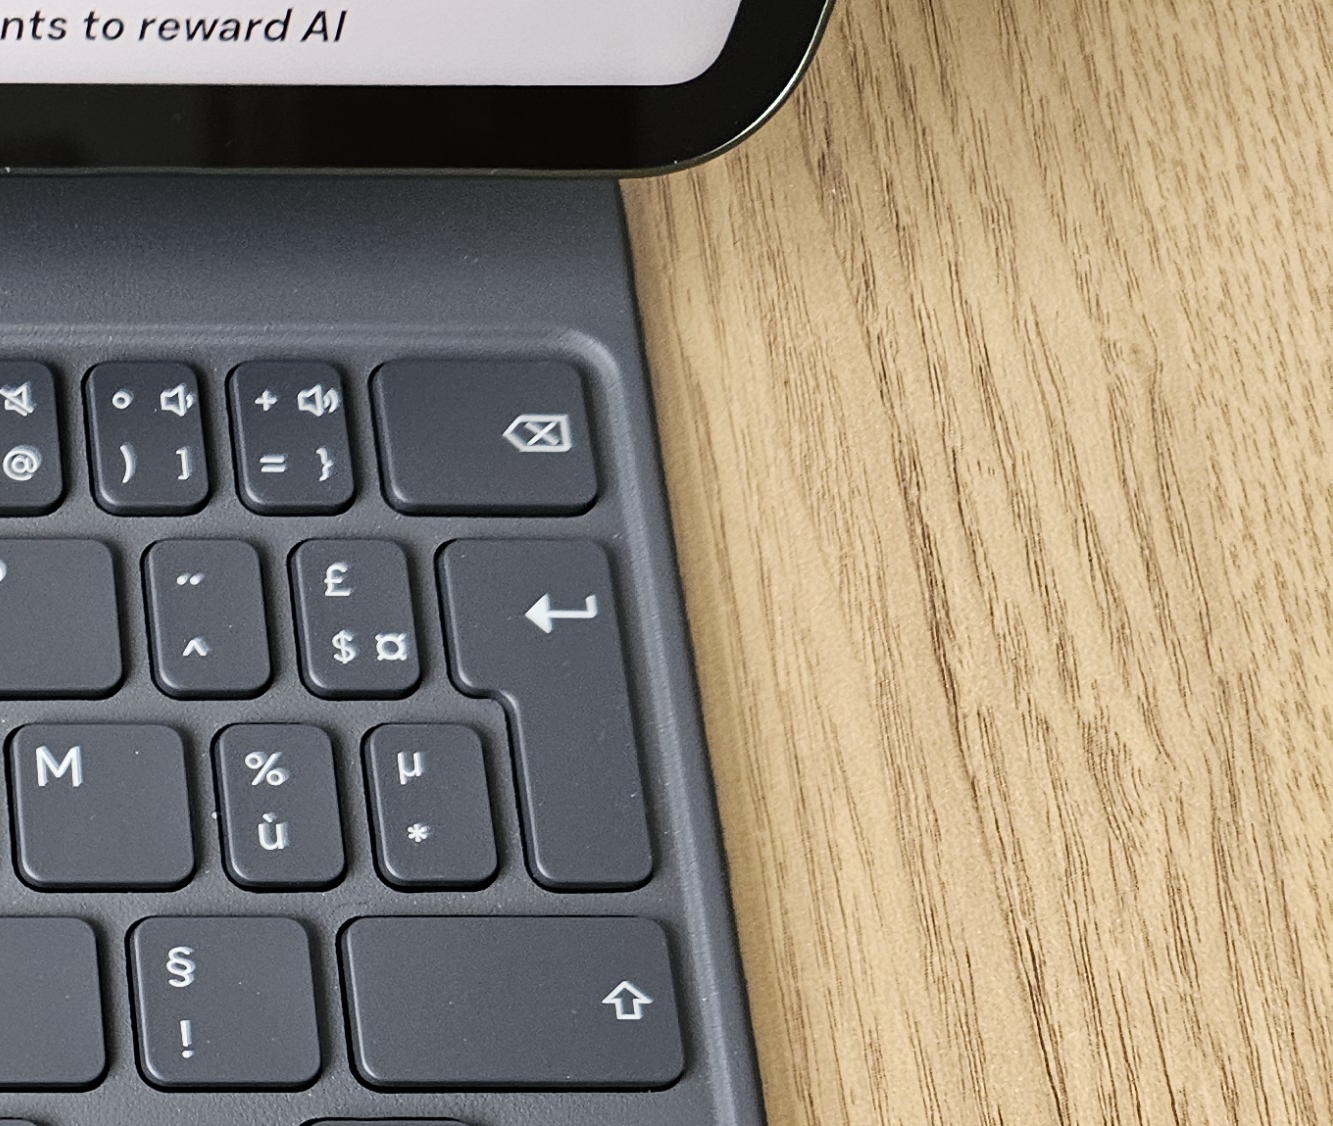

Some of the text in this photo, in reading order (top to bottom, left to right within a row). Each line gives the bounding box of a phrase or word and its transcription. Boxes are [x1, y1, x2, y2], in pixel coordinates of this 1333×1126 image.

[83, 10, 125, 41] to
[138, 7, 293, 42] reward
[300, 9, 348, 43] AI
[254, 389, 278, 412] +
[2, 446, 41, 482] @
[119, 444, 135, 484] )
[175, 447, 190, 480] ]
[259, 455, 286, 473] =
[315, 447, 334, 482] }
[323, 562, 351, 597] £
[331, 629, 357, 665] $
[35, 745, 83, 788] M
[244, 751, 288, 786] %
[258, 813, 287, 851] ù
[165, 946, 196, 988] §
[179, 1019, 194, 1059] !
